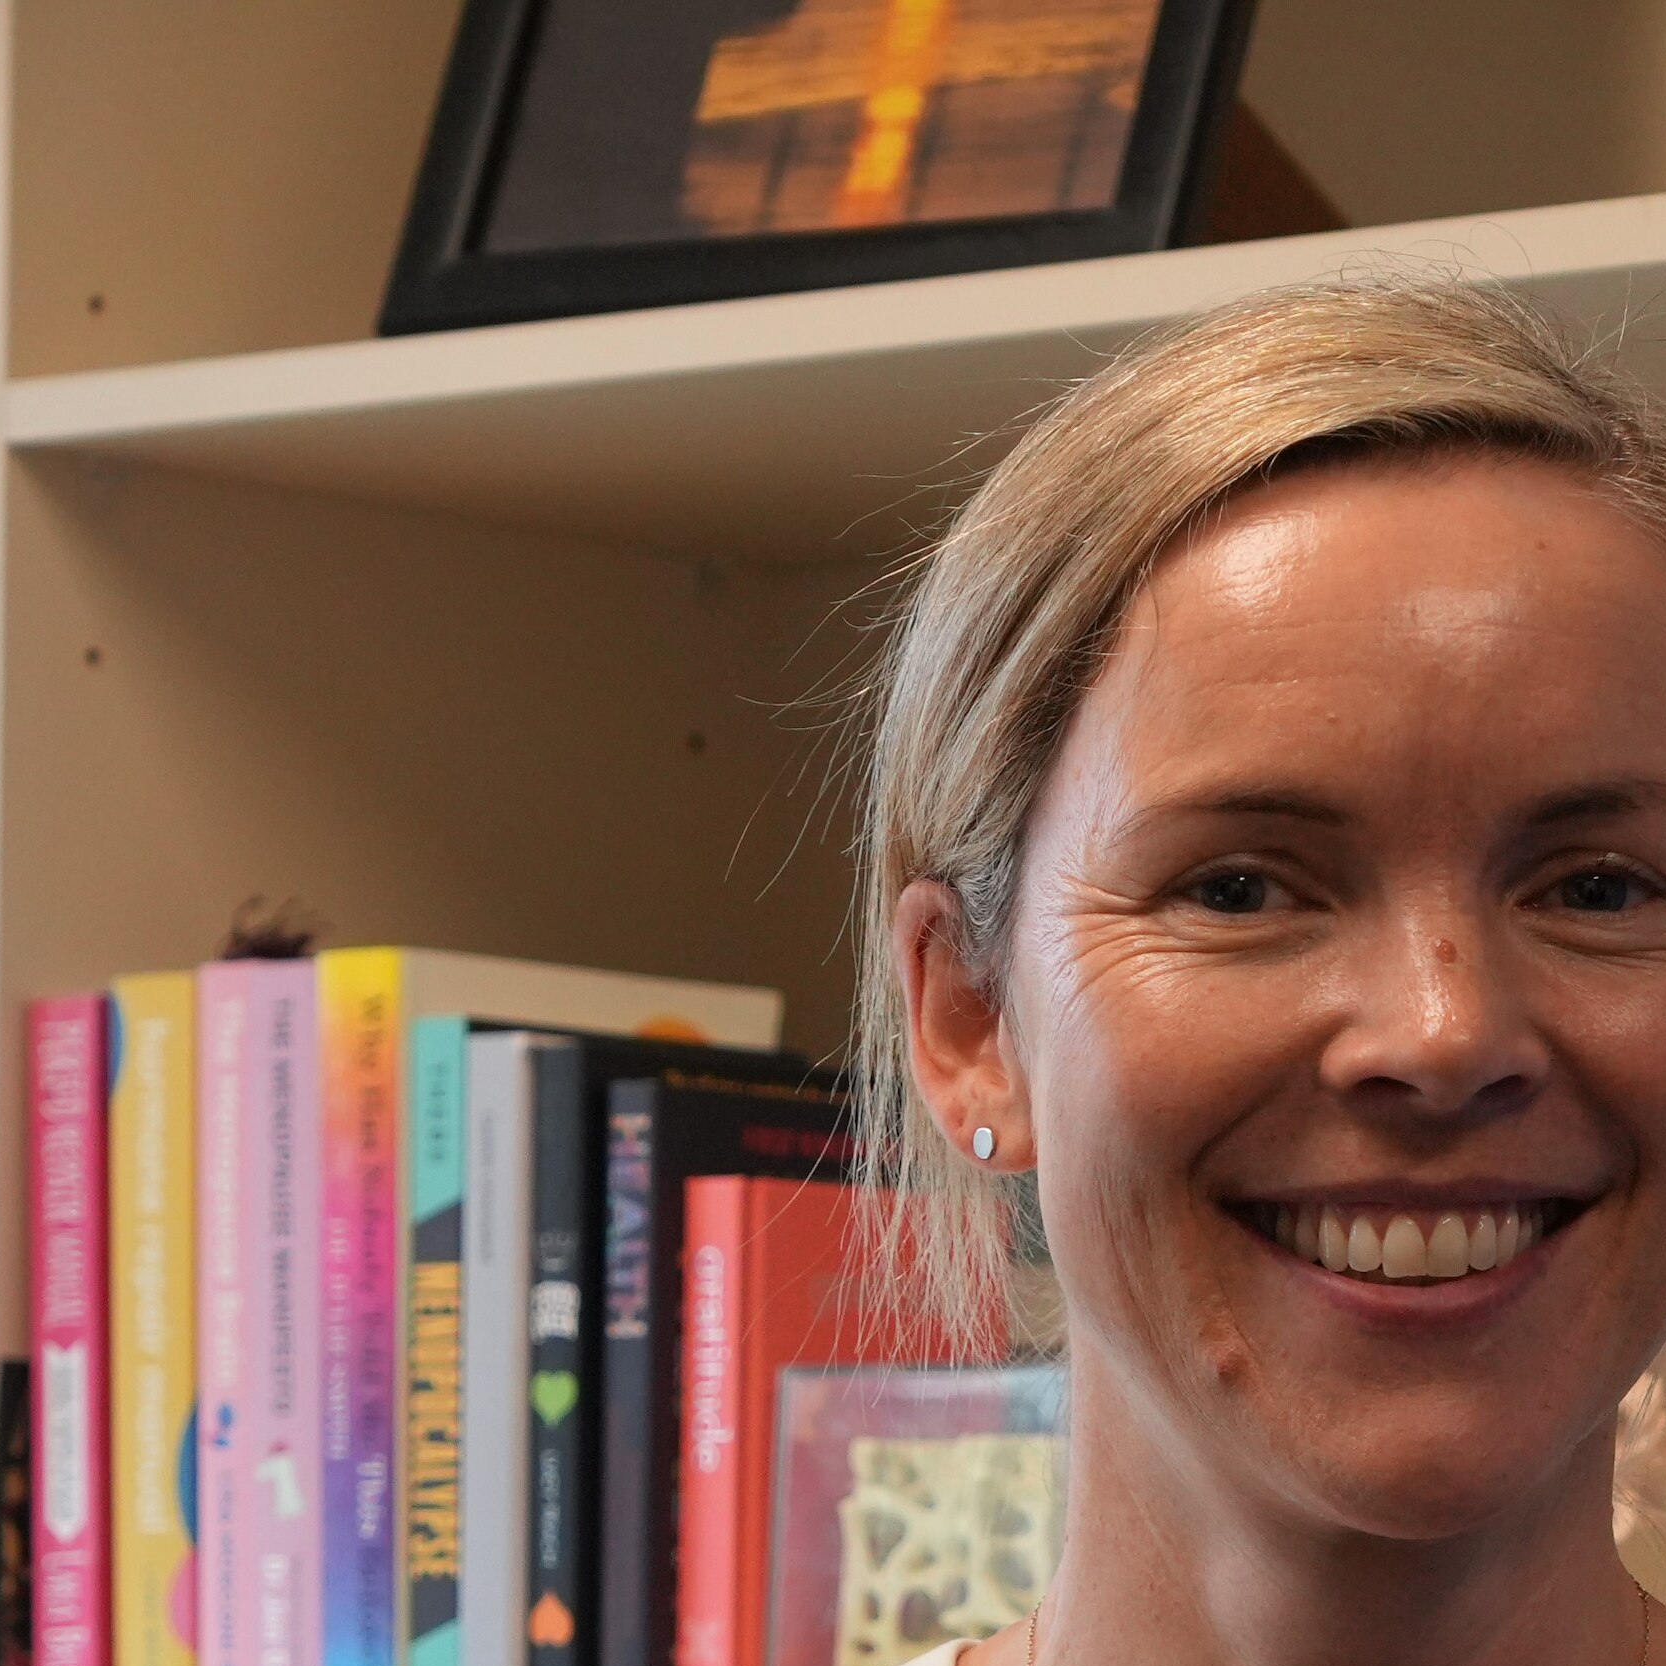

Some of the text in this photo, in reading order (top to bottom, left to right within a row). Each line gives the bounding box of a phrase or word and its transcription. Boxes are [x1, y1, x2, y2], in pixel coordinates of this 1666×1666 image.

[353, 994, 385, 1068] Why
[360, 1085, 385, 1151] Has
[209, 999, 245, 1387] The Menopause Brain
[271, 999, 297, 1419] THE MENOPAUSE MANIFESTO
[327, 1217, 352, 1264] DR
[355, 1164, 384, 1295] Nobody
[604, 1112, 654, 1341] HEALTH
[43, 1230, 86, 1326] MANUAL
[130, 1017, 173, 1534] hormone repair manual
[359, 1310, 384, 1388] Told
[692, 1245, 735, 1474] gratitude
[410, 1261, 461, 1579] MENOPOCALYPSE
[357, 1453, 388, 1540] This
[261, 1555, 290, 1587] Dr
